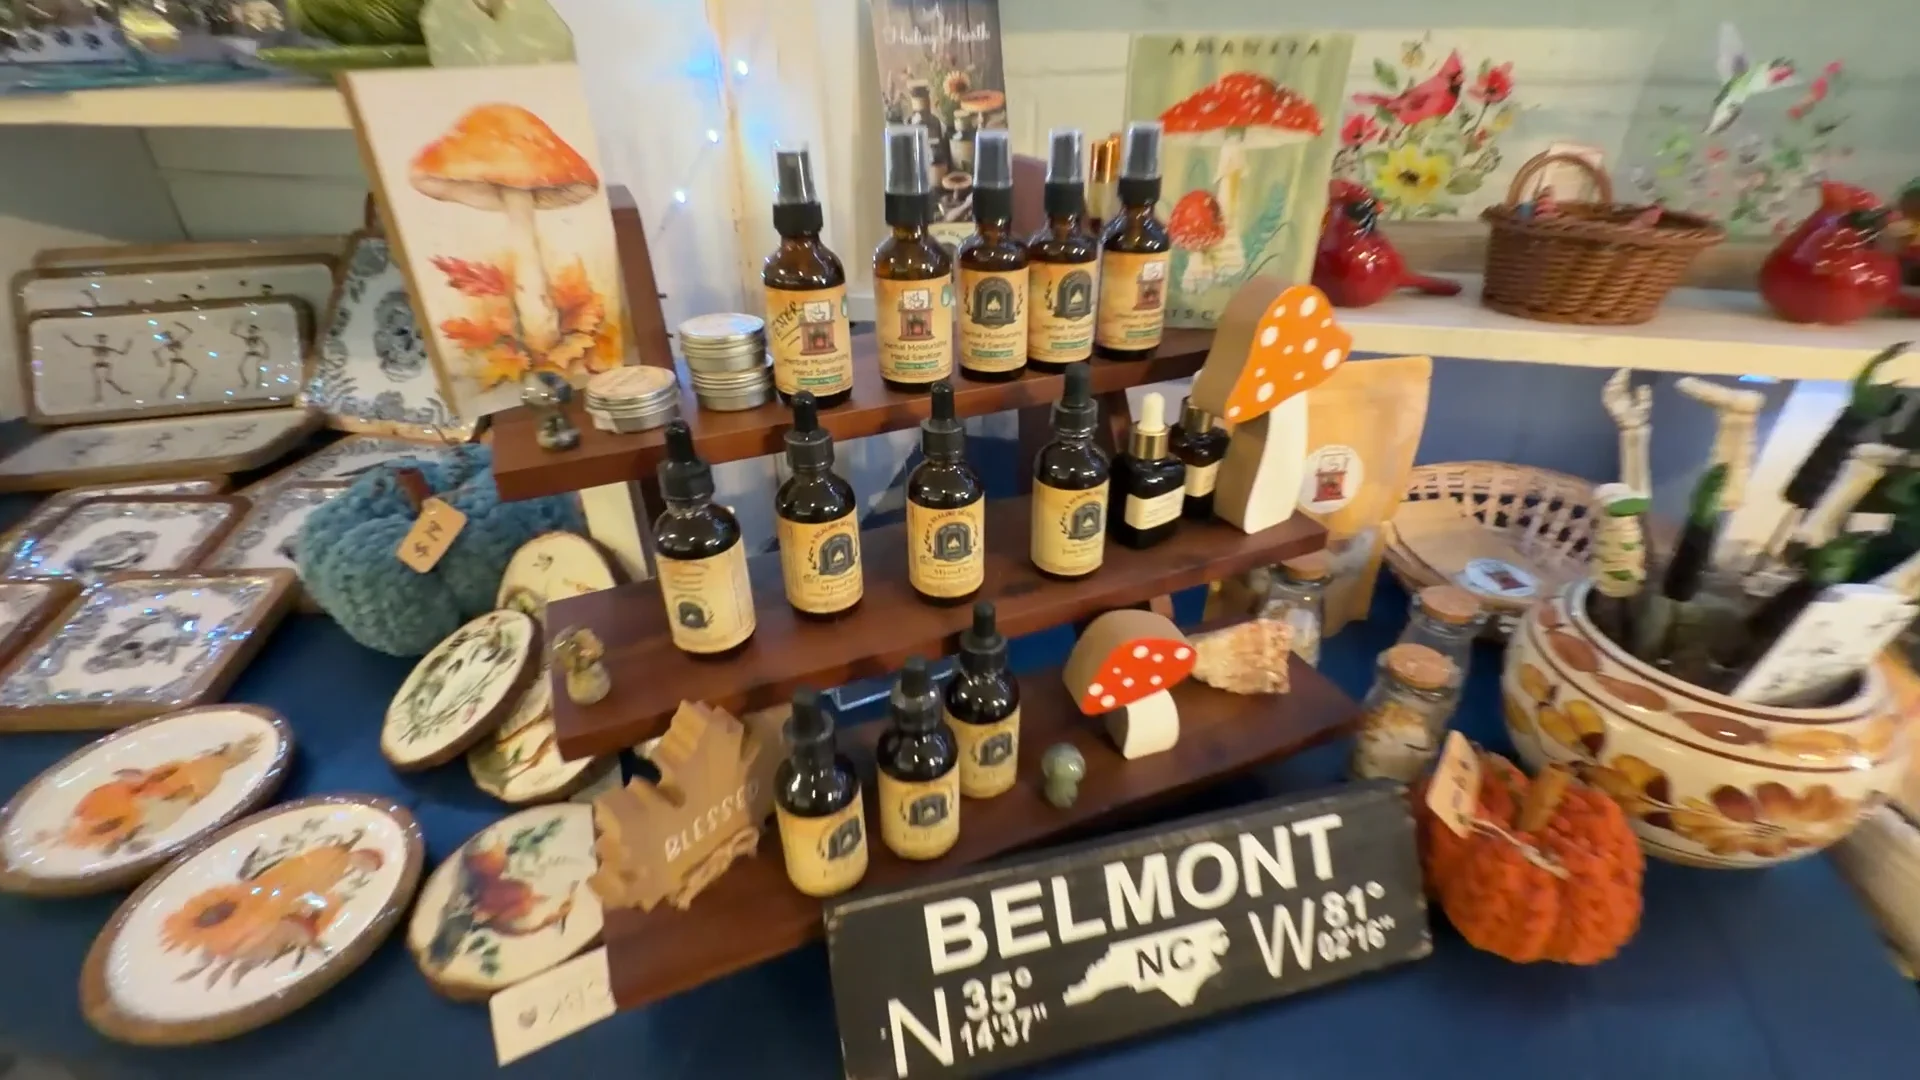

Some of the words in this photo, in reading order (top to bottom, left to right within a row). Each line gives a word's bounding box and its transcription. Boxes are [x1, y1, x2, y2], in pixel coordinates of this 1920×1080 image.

[664, 778, 760, 863] BLESSED
[923, 813, 1343, 975] BELMONT
[1247, 897, 1316, 979] W
[1321, 880, 1386, 929] 81°
[1135, 936, 1196, 981] NC
[887, 986, 954, 1079] N
[961, 966, 1033, 1022] 35°
